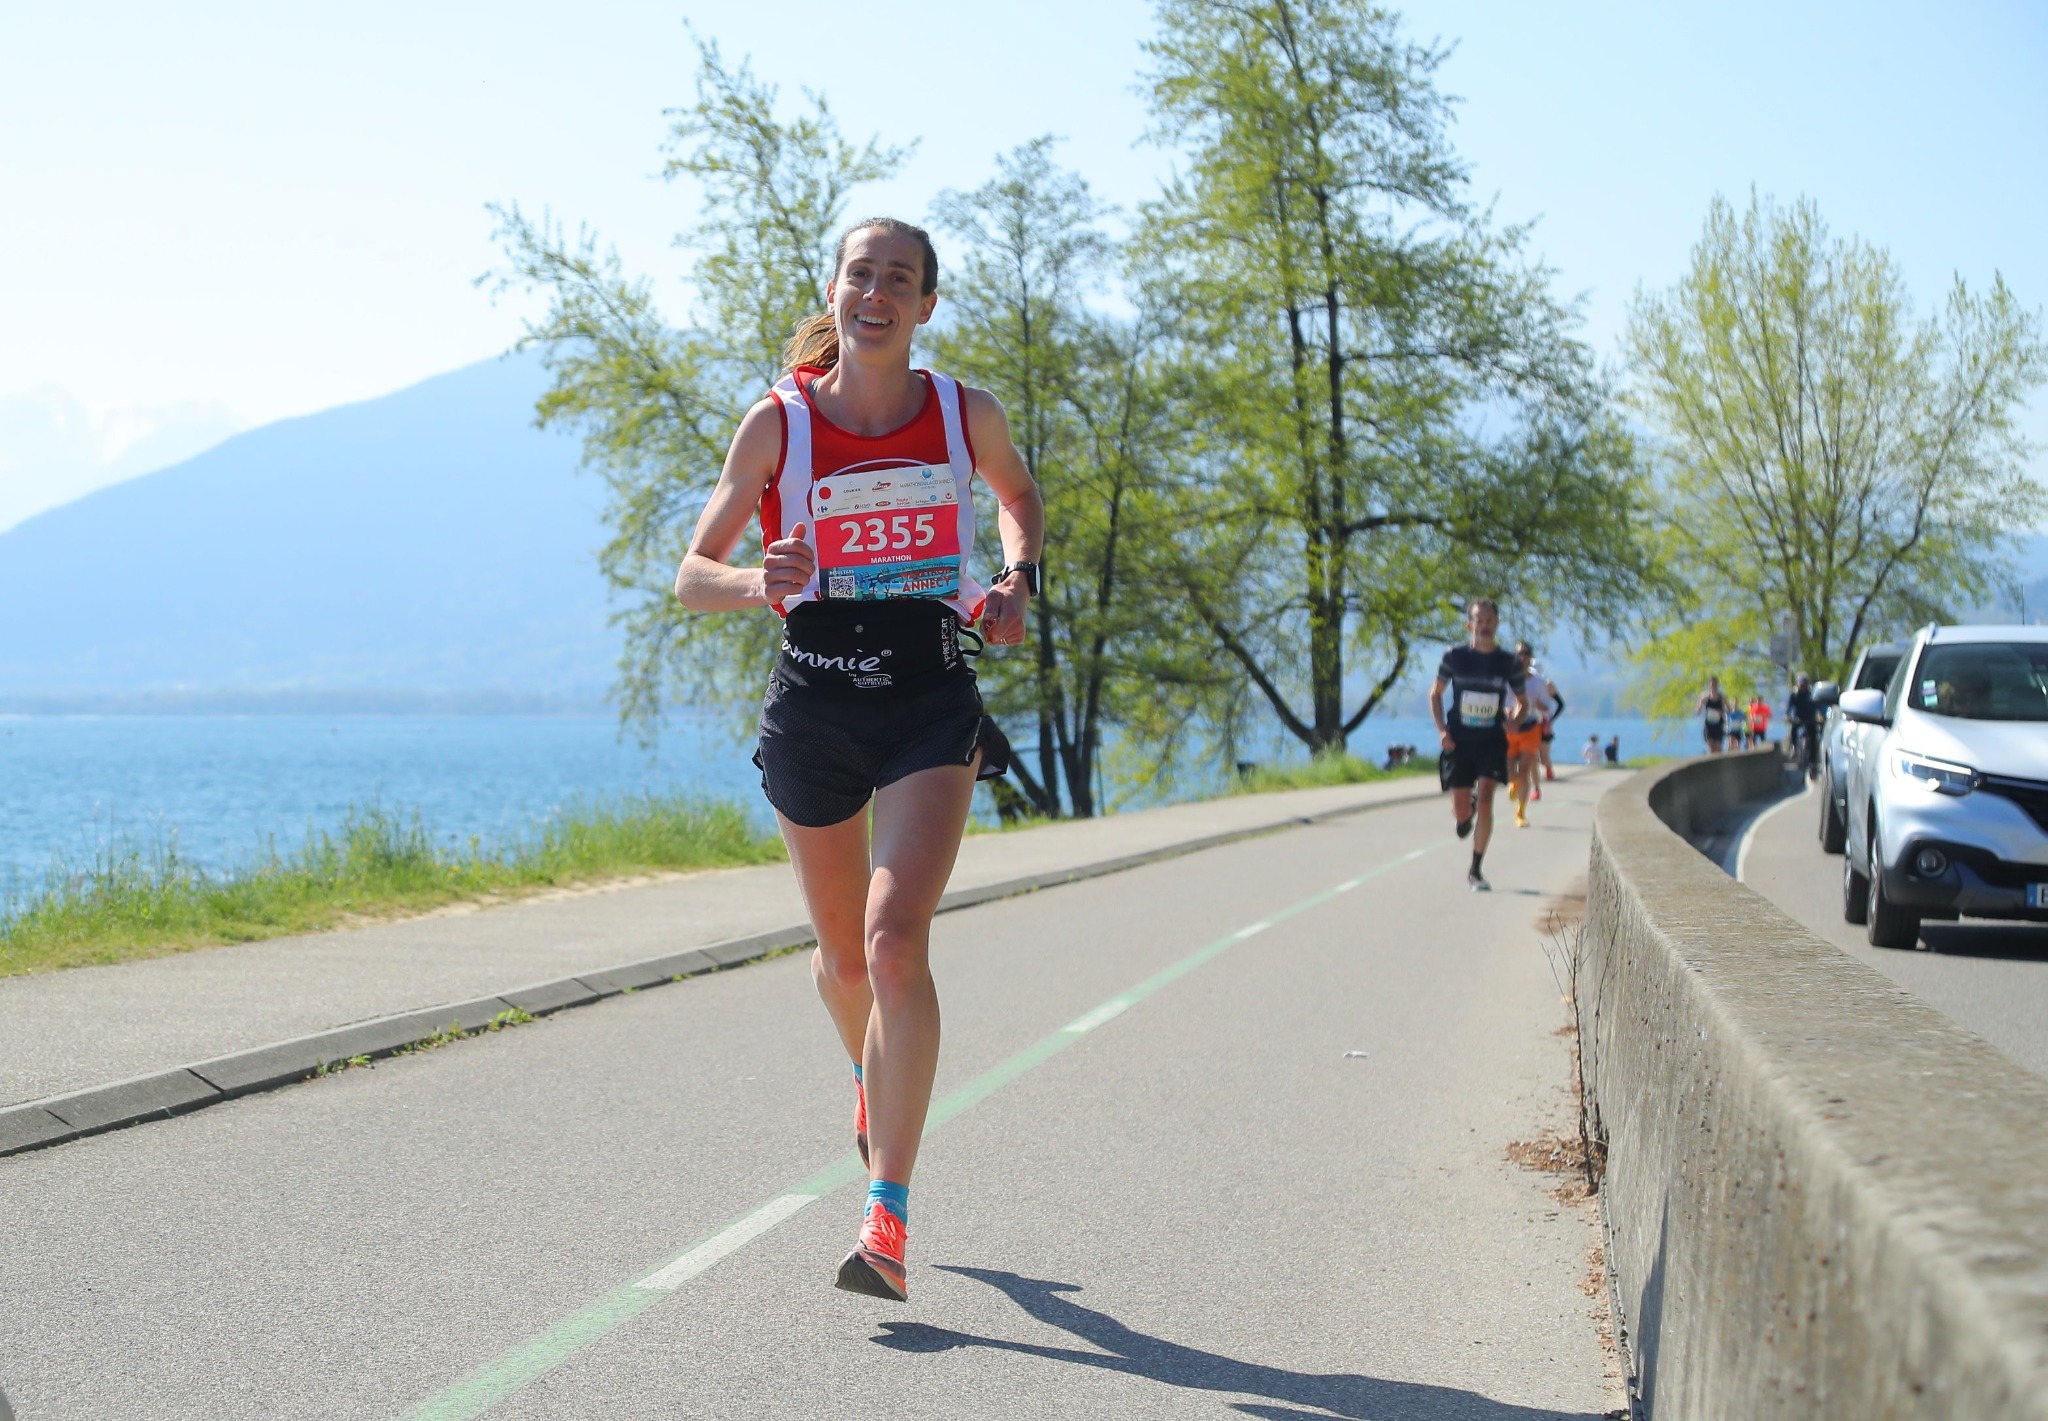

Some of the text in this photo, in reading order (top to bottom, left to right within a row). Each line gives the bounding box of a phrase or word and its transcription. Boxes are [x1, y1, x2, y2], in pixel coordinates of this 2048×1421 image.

[840, 514, 935, 553] 2355
[870, 555, 912, 564] MARATHON
[902, 575, 951, 593] ANNECY
